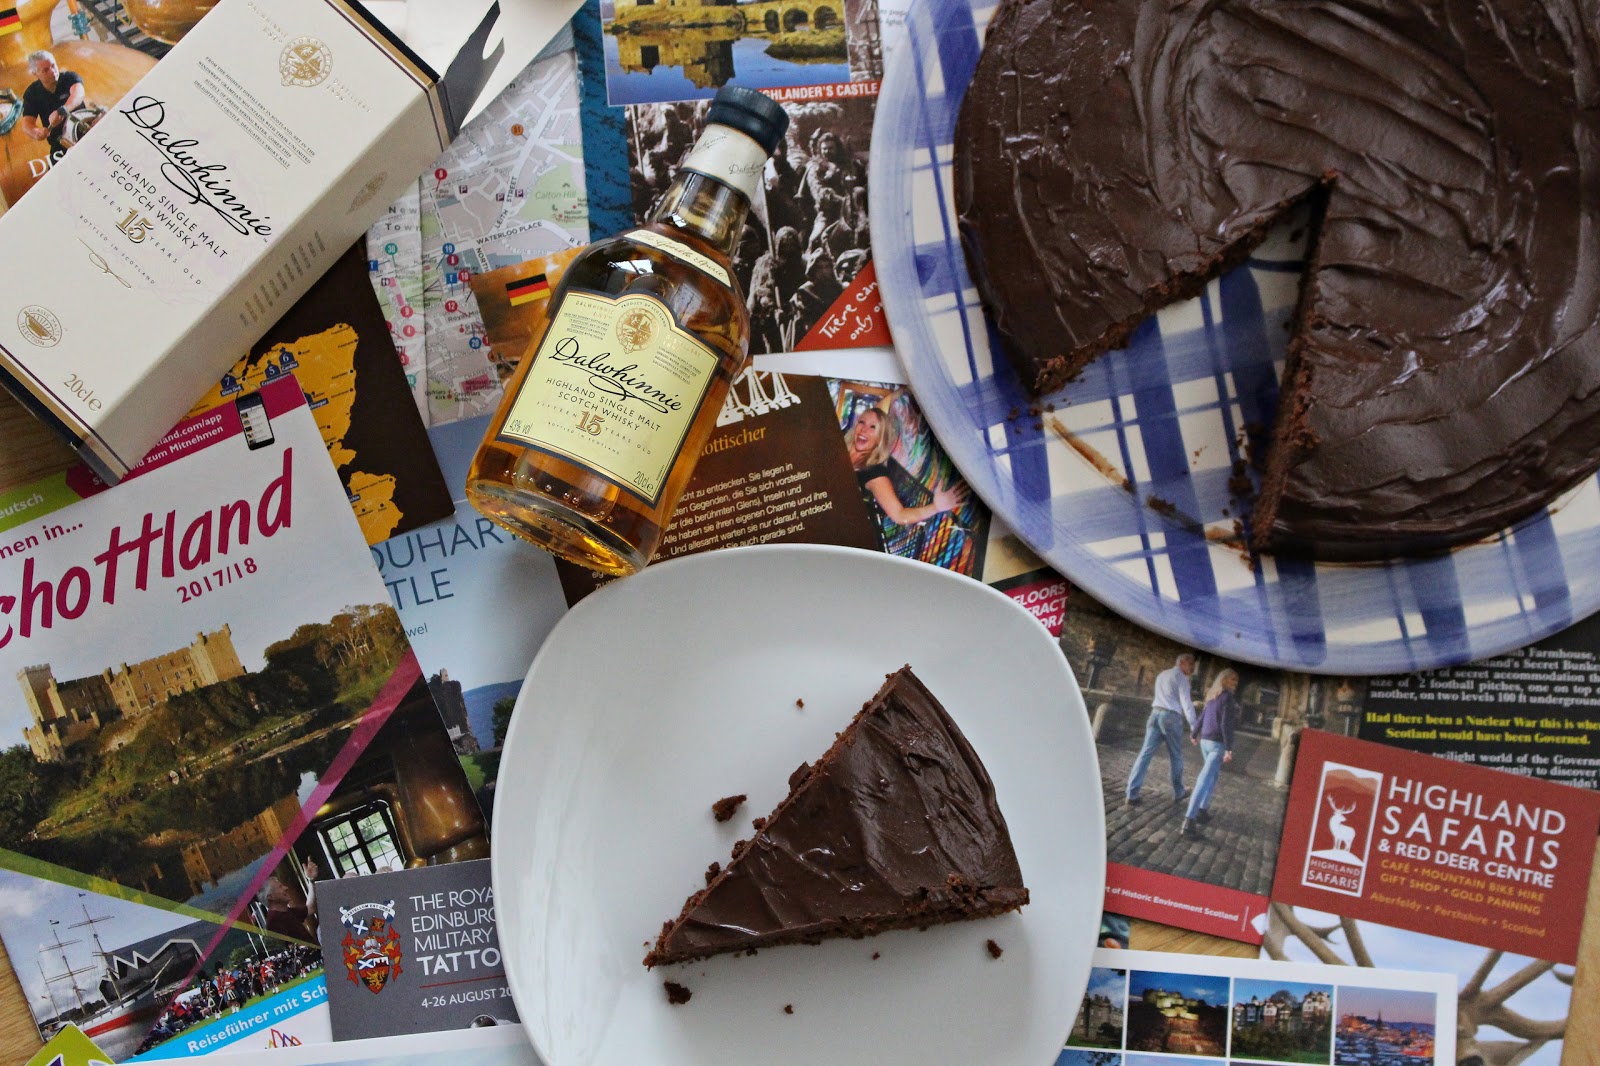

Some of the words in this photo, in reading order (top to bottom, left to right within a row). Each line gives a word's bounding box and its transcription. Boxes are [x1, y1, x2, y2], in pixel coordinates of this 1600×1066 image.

[836, 80, 878, 96] CASTLE
[120, 96, 272, 236] Dalwhinnie
[100, 143, 156, 194] HIGHLAND
[158, 195, 197, 231] SINGLE
[198, 231, 227, 258] MALT
[110, 170, 155, 211] SCOTCH
[156, 210, 198, 249] WHISKY
[388, 206, 418, 214] New
[494, 209, 510, 229] LEITH
[507, 176, 518, 203] STREET
[77, 171, 122, 212] FIFTEEN
[115, 207, 154, 244] 15
[149, 236, 177, 263] YEARS
[183, 267, 201, 284] OLD
[385, 222, 421, 232] Town
[476, 229, 518, 244] WATERLOO
[518, 221, 543, 234] PLACE
[818, 305, 858, 339] There
[856, 282, 878, 302] can
[850, 314, 874, 341] only
[548, 336, 682, 414] Dalwhinnie
[545, 377, 595, 403] HIGHLAND
[599, 396, 634, 417] SINGLE
[637, 414, 660, 431] MALT
[558, 391, 598, 411] SCOTCH
[602, 407, 640, 430] WHISKY
[574, 410, 606, 437] 15
[146, 450, 168, 463] zum
[169, 426, 223, 453] Mitnehmen
[701, 426, 766, 456] ottischer
[689, 494, 730, 511] Gegenden,
[731, 490, 744, 499] die
[744, 486, 757, 495] Sie
[758, 480, 774, 491] sich
[775, 470, 810, 486] vorstellen
[695, 489, 705, 497] zu
[706, 477, 746, 494] entdecken.
[748, 472, 761, 481] Sie
[761, 465, 784, 477] liegen
[785, 462, 793, 471] in
[663, 534, 677, 545] Alle
[678, 527, 702, 540] haben
[703, 523, 714, 533] sie
[715, 518, 734, 529] ihren
[735, 509, 765, 524] eigenen
[765, 500, 796, 514] Charme
[796, 493, 812, 505] und
[813, 491, 827, 500] ihre
[679, 517, 693, 528] (die
[694, 505, 735, 523] berühmten
[735, 496, 762, 510] Glens),
[763, 490, 785, 502] Inseln
[786, 484, 802, 496] und
[42, 522, 83, 541] in...
[670, 543, 687, 555] Und
[688, 534, 719, 550] allesamt
[719, 527, 746, 540] warten
[746, 523, 758, 533] sie
[759, 519, 772, 529] nur
[772, 510, 799, 525] darauf,
[799, 501, 832, 517] entdeckt
[760, 527, 787, 546] gerade
[787, 523, 805, 534] sind.
[370, 518, 516, 578] UHAR
[176, 557, 258, 603] 2017/18
[1493, 671, 1584, 683] accommodation
[1523, 658, 1559, 669] Secret
[1370, 690, 1417, 701] another,
[1419, 692, 1434, 700] on
[1437, 692, 1458, 701] two
[1461, 692, 1494, 701] levels
[1498, 693, 1516, 702] 100
[1419, 679, 1426, 688] 2
[1430, 679, 1474, 690] football
[1479, 681, 1524, 693] pitches,
[1528, 685, 1549, 693] one
[1573, 684, 1592, 696] top
[1366, 712, 1390, 723] Had
[1393, 713, 1423, 724] there
[1426, 714, 1452, 725] been
[1466, 715, 1510, 727] Nuclear
[1514, 716, 1536, 728] War
[1539, 718, 1561, 729] this
[1564, 719, 1575, 729] is
[1386, 728, 1436, 739] Scotland
[1440, 729, 1473, 740] would
[1476, 730, 1501, 741] have
[1505, 731, 1531, 742] been
[1534, 732, 1590, 745] Governed.
[1480, 752, 1512, 763] world
[1516, 754, 1528, 764] of
[1531, 754, 1550, 764] the
[1535, 767, 1548, 776] to
[1550, 766, 1596, 777] discover
[1389, 776, 1565, 834] HIGHLAND
[1382, 806, 1558, 868] SAFARIS
[1308, 869, 1358, 889] SAFARIS
[1310, 859, 1361, 876] HIGHLAND
[1377, 838, 1390, 852] &
[1395, 841, 1430, 860] RED
[1434, 850, 1479, 872] DEER
[1484, 861, 1554, 888] CENTRE
[1380, 872, 1406, 885] GIFT
[1409, 878, 1440, 891] SHOP
[1450, 888, 1484, 902] GOLD
[1486, 896, 1540, 915] PANNING
[1381, 858, 1410, 873] CAFÉ
[1421, 868, 1486, 889] MOUNTAIN
[1488, 881, 1515, 896] BIKE
[1517, 886, 1545, 903] HIRE
[409, 893, 446, 912] THE
[450, 886, 494, 908] ROYA
[1121, 889, 1152, 901] Historic
[1153, 896, 1203, 913] Environment
[1204, 907, 1239, 921] Scotland
[1369, 891, 1422, 911] Aberfeldy
[1434, 904, 1488, 924] Perthshire
[1501, 919, 1545, 937] Scotland
[414, 927, 493, 952] MILITARY
[416, 948, 500, 976] TATTO
[422, 995, 446, 1008] 4-26
[449, 989, 496, 1005] AUGUST
[187, 1012, 270, 1053] Reiseführer
[274, 998, 299, 1018] mit
